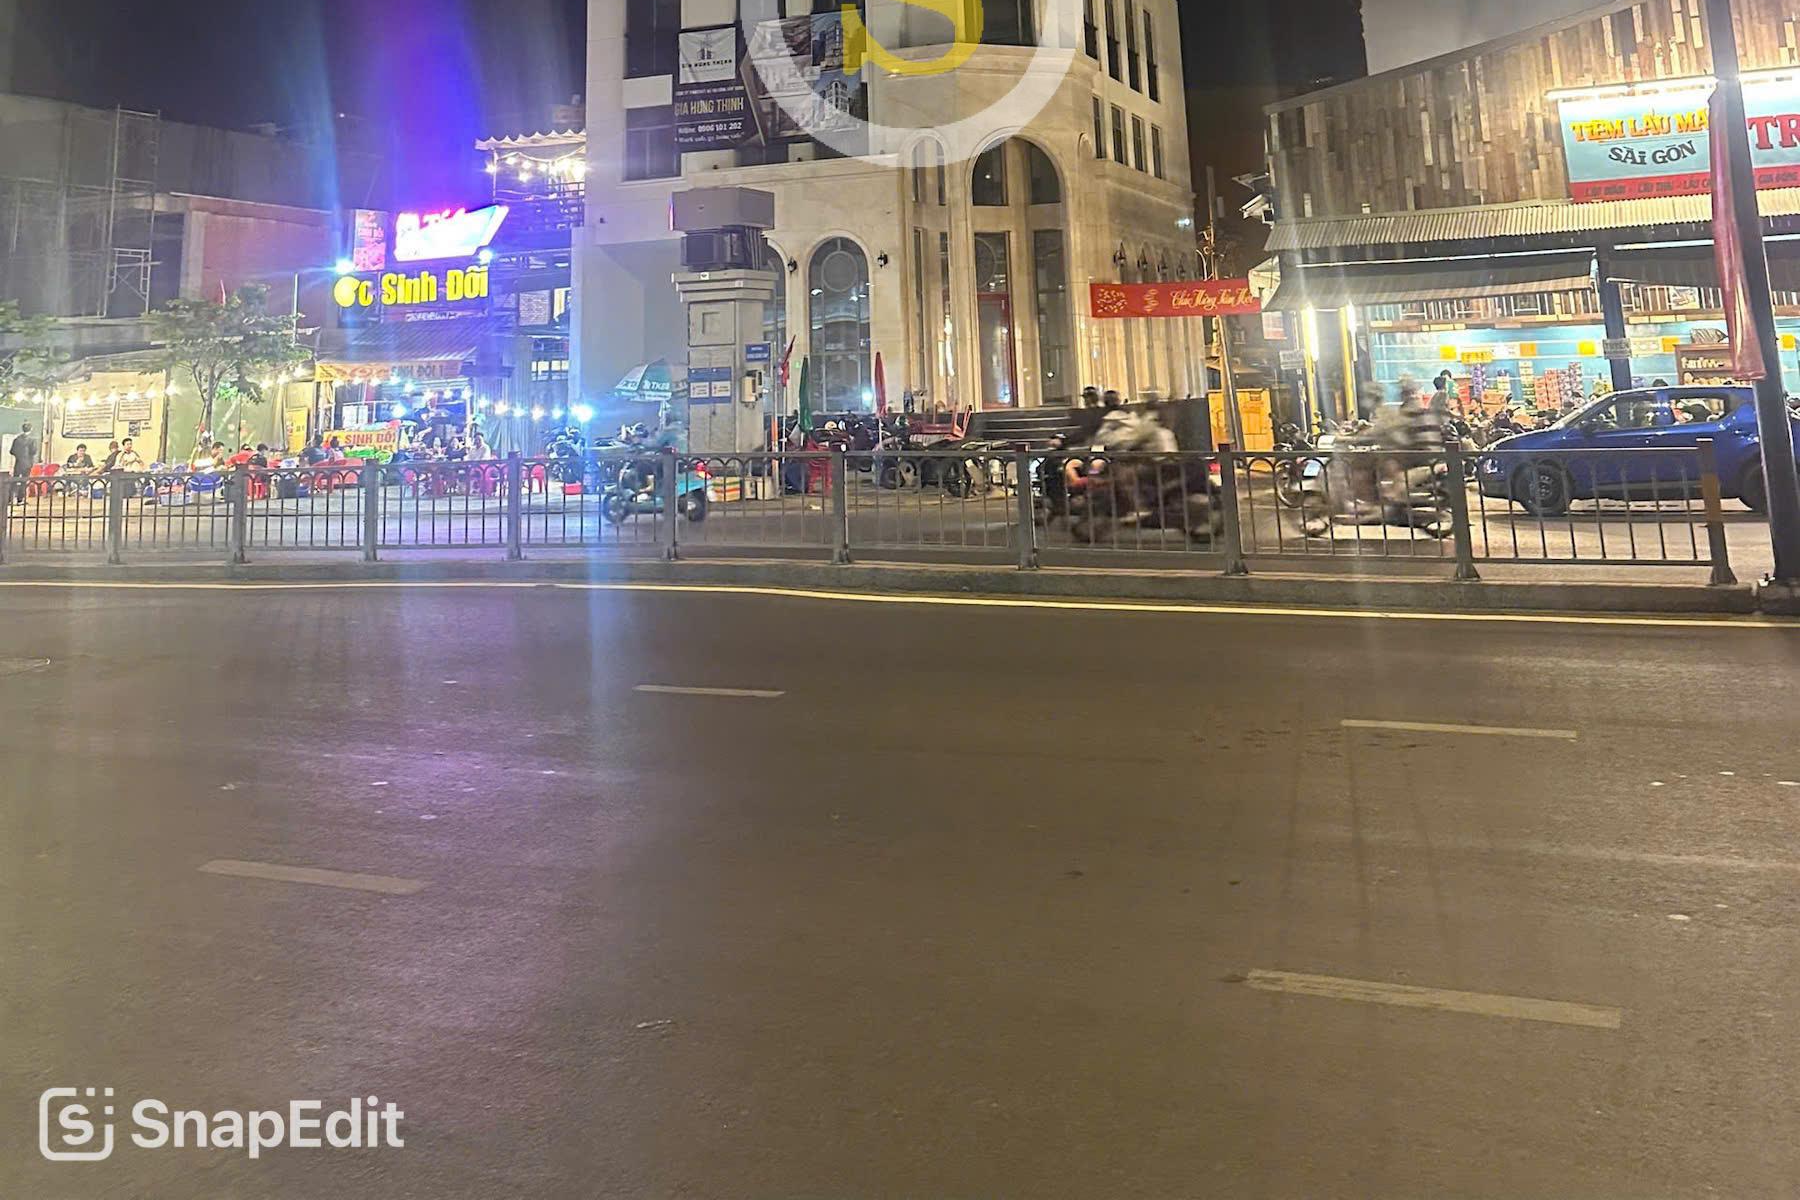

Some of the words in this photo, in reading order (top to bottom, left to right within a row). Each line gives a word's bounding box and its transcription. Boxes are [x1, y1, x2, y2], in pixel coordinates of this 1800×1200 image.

[674, 102, 689, 116] GIA
[381, 271, 437, 305] Sinh
[446, 265, 488, 301] Đôi
[345, 433, 373, 445] SINH
